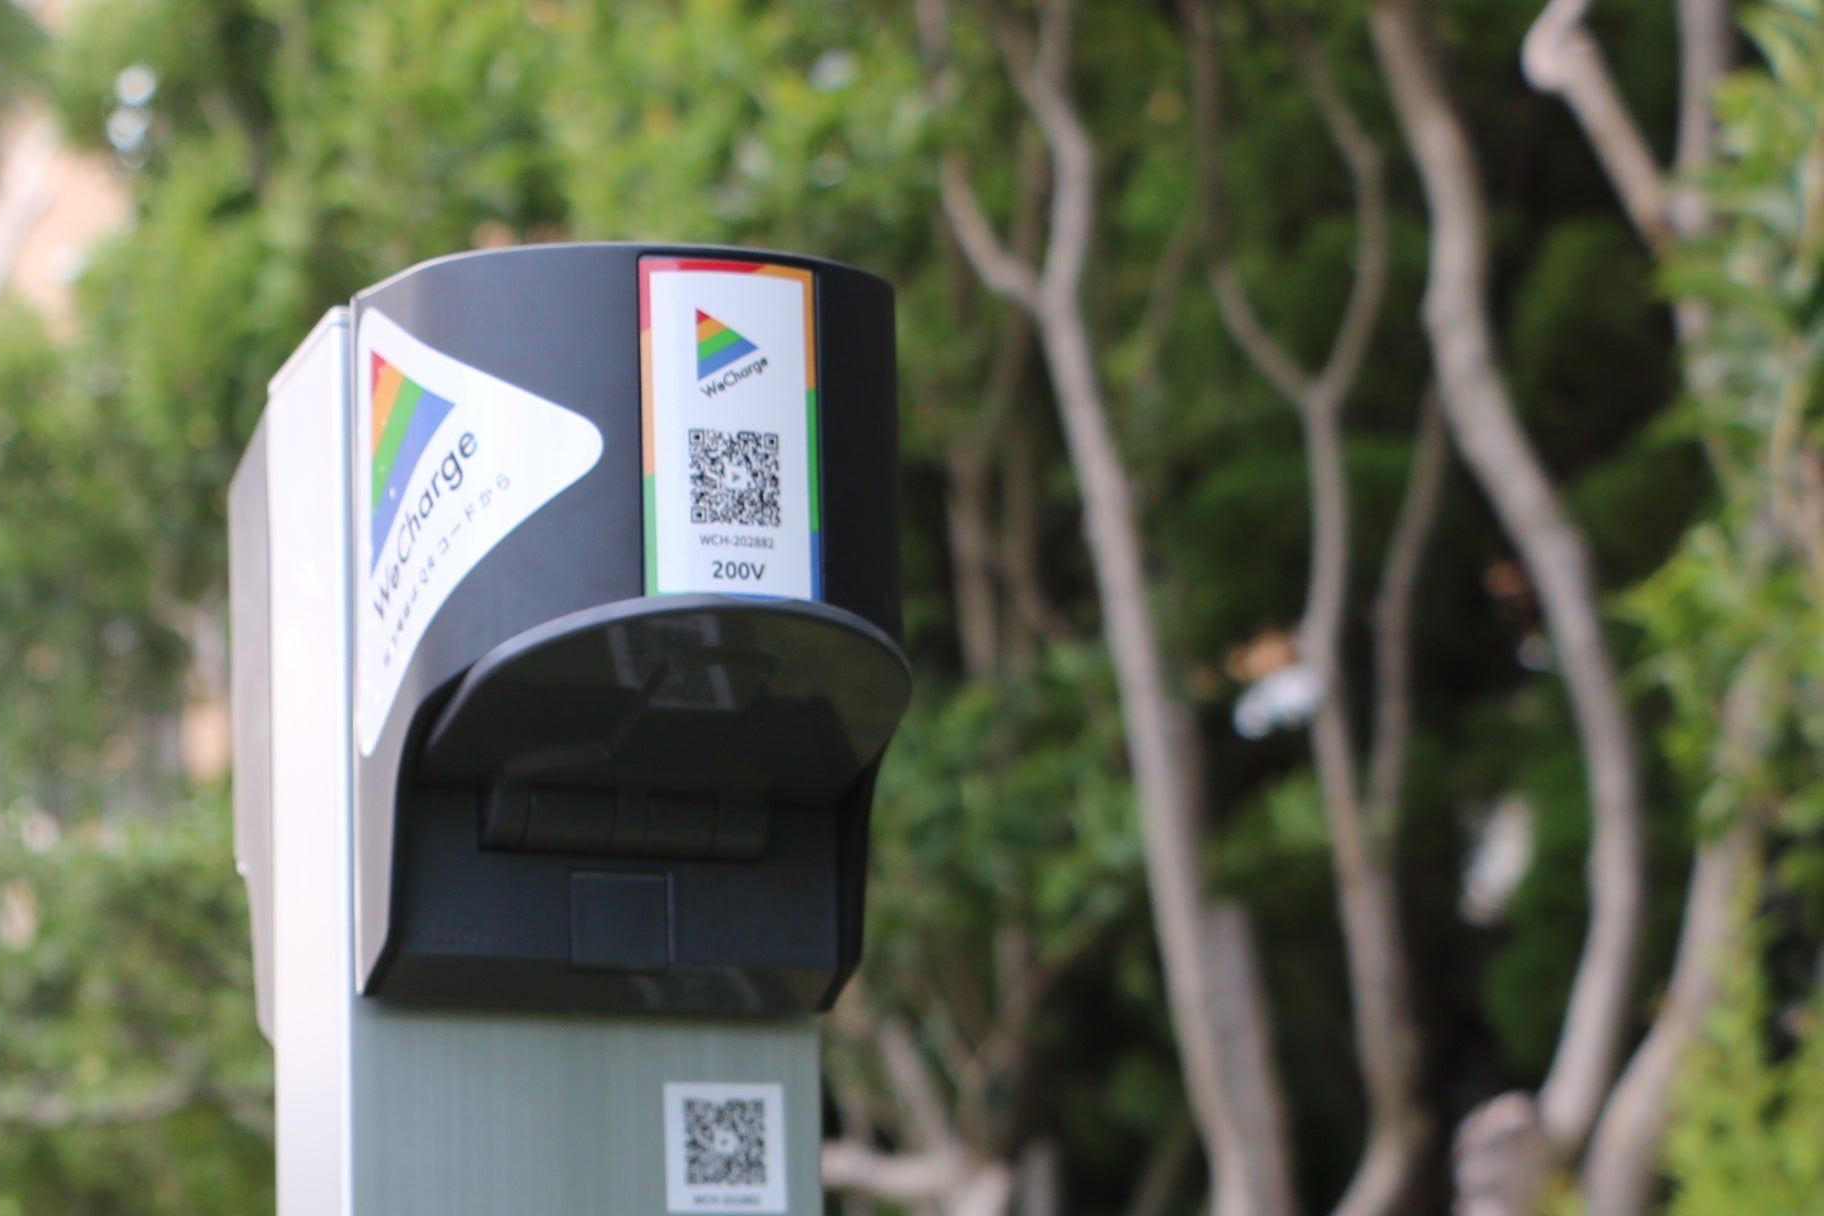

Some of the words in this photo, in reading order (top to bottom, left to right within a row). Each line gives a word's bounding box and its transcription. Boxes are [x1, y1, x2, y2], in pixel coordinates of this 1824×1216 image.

[699, 357, 768, 398] WeCharge
[373, 431, 478, 621] WeCharge
[712, 560, 765, 580] 200V
